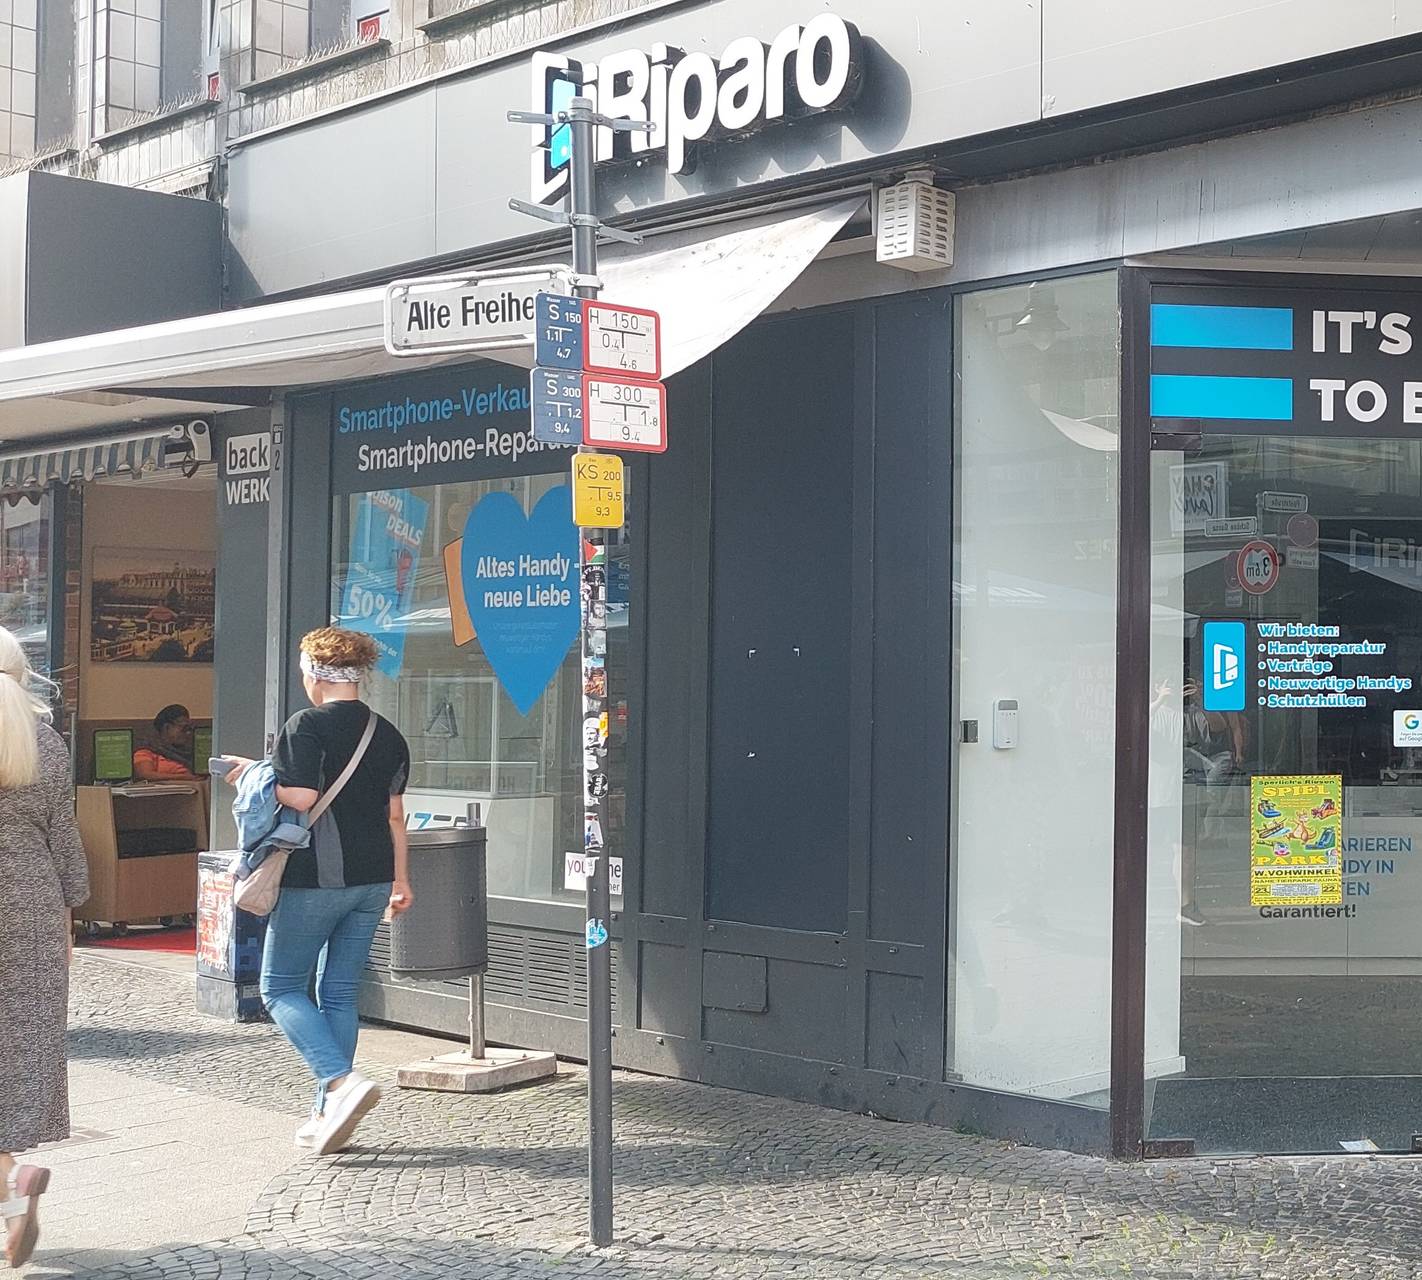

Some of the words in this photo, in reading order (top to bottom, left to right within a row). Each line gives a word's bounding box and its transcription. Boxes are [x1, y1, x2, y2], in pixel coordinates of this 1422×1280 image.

[582, 12, 850, 174] iRiparo
[407, 301, 450, 332] Alte
[461, 291, 535, 326] Freihe
[548, 304, 560, 320] S
[565, 312, 582, 324] 150
[590, 309, 599, 324] H
[612, 312, 639, 329] 150
[1312, 310, 1413, 356] IT'S
[546, 379, 558, 395] S
[562, 386, 581, 398] 300
[590, 383, 600, 398] H
[613, 385, 642, 403] 300
[339, 384, 531, 434] Smartphone-Verkau
[1309, 379, 1388, 422] TO
[229, 437, 268, 471] back
[358, 428, 577, 472] Smartphone-Repa
[577, 463, 599, 479] KS
[603, 470, 621, 481] 200
[226, 477, 271, 505] WERK
[386, 514, 423, 546] DEALS
[476, 556, 515, 579] Altes
[519, 553, 570, 582] Handy
[484, 590, 523, 608] neue
[526, 584, 571, 607] Liebe
[348, 584, 393, 631] 50%
[1257, 623, 1287, 637] Wir
[1287, 623, 1340, 637] bieten:
[1267, 640, 1386, 657] Handyreparatur
[1267, 659, 1333, 674] Verträge
[1267, 677, 1355, 692] Neuwertige
[1356, 676, 1412, 692] Handys
[1267, 694, 1367, 708] Schutzhüllen
[1262, 785, 1331, 797] SPIEL
[1256, 855, 1327, 866] PARK
[1376, 860, 1393, 873] IN
[1260, 904, 1356, 919] Garantiert!
